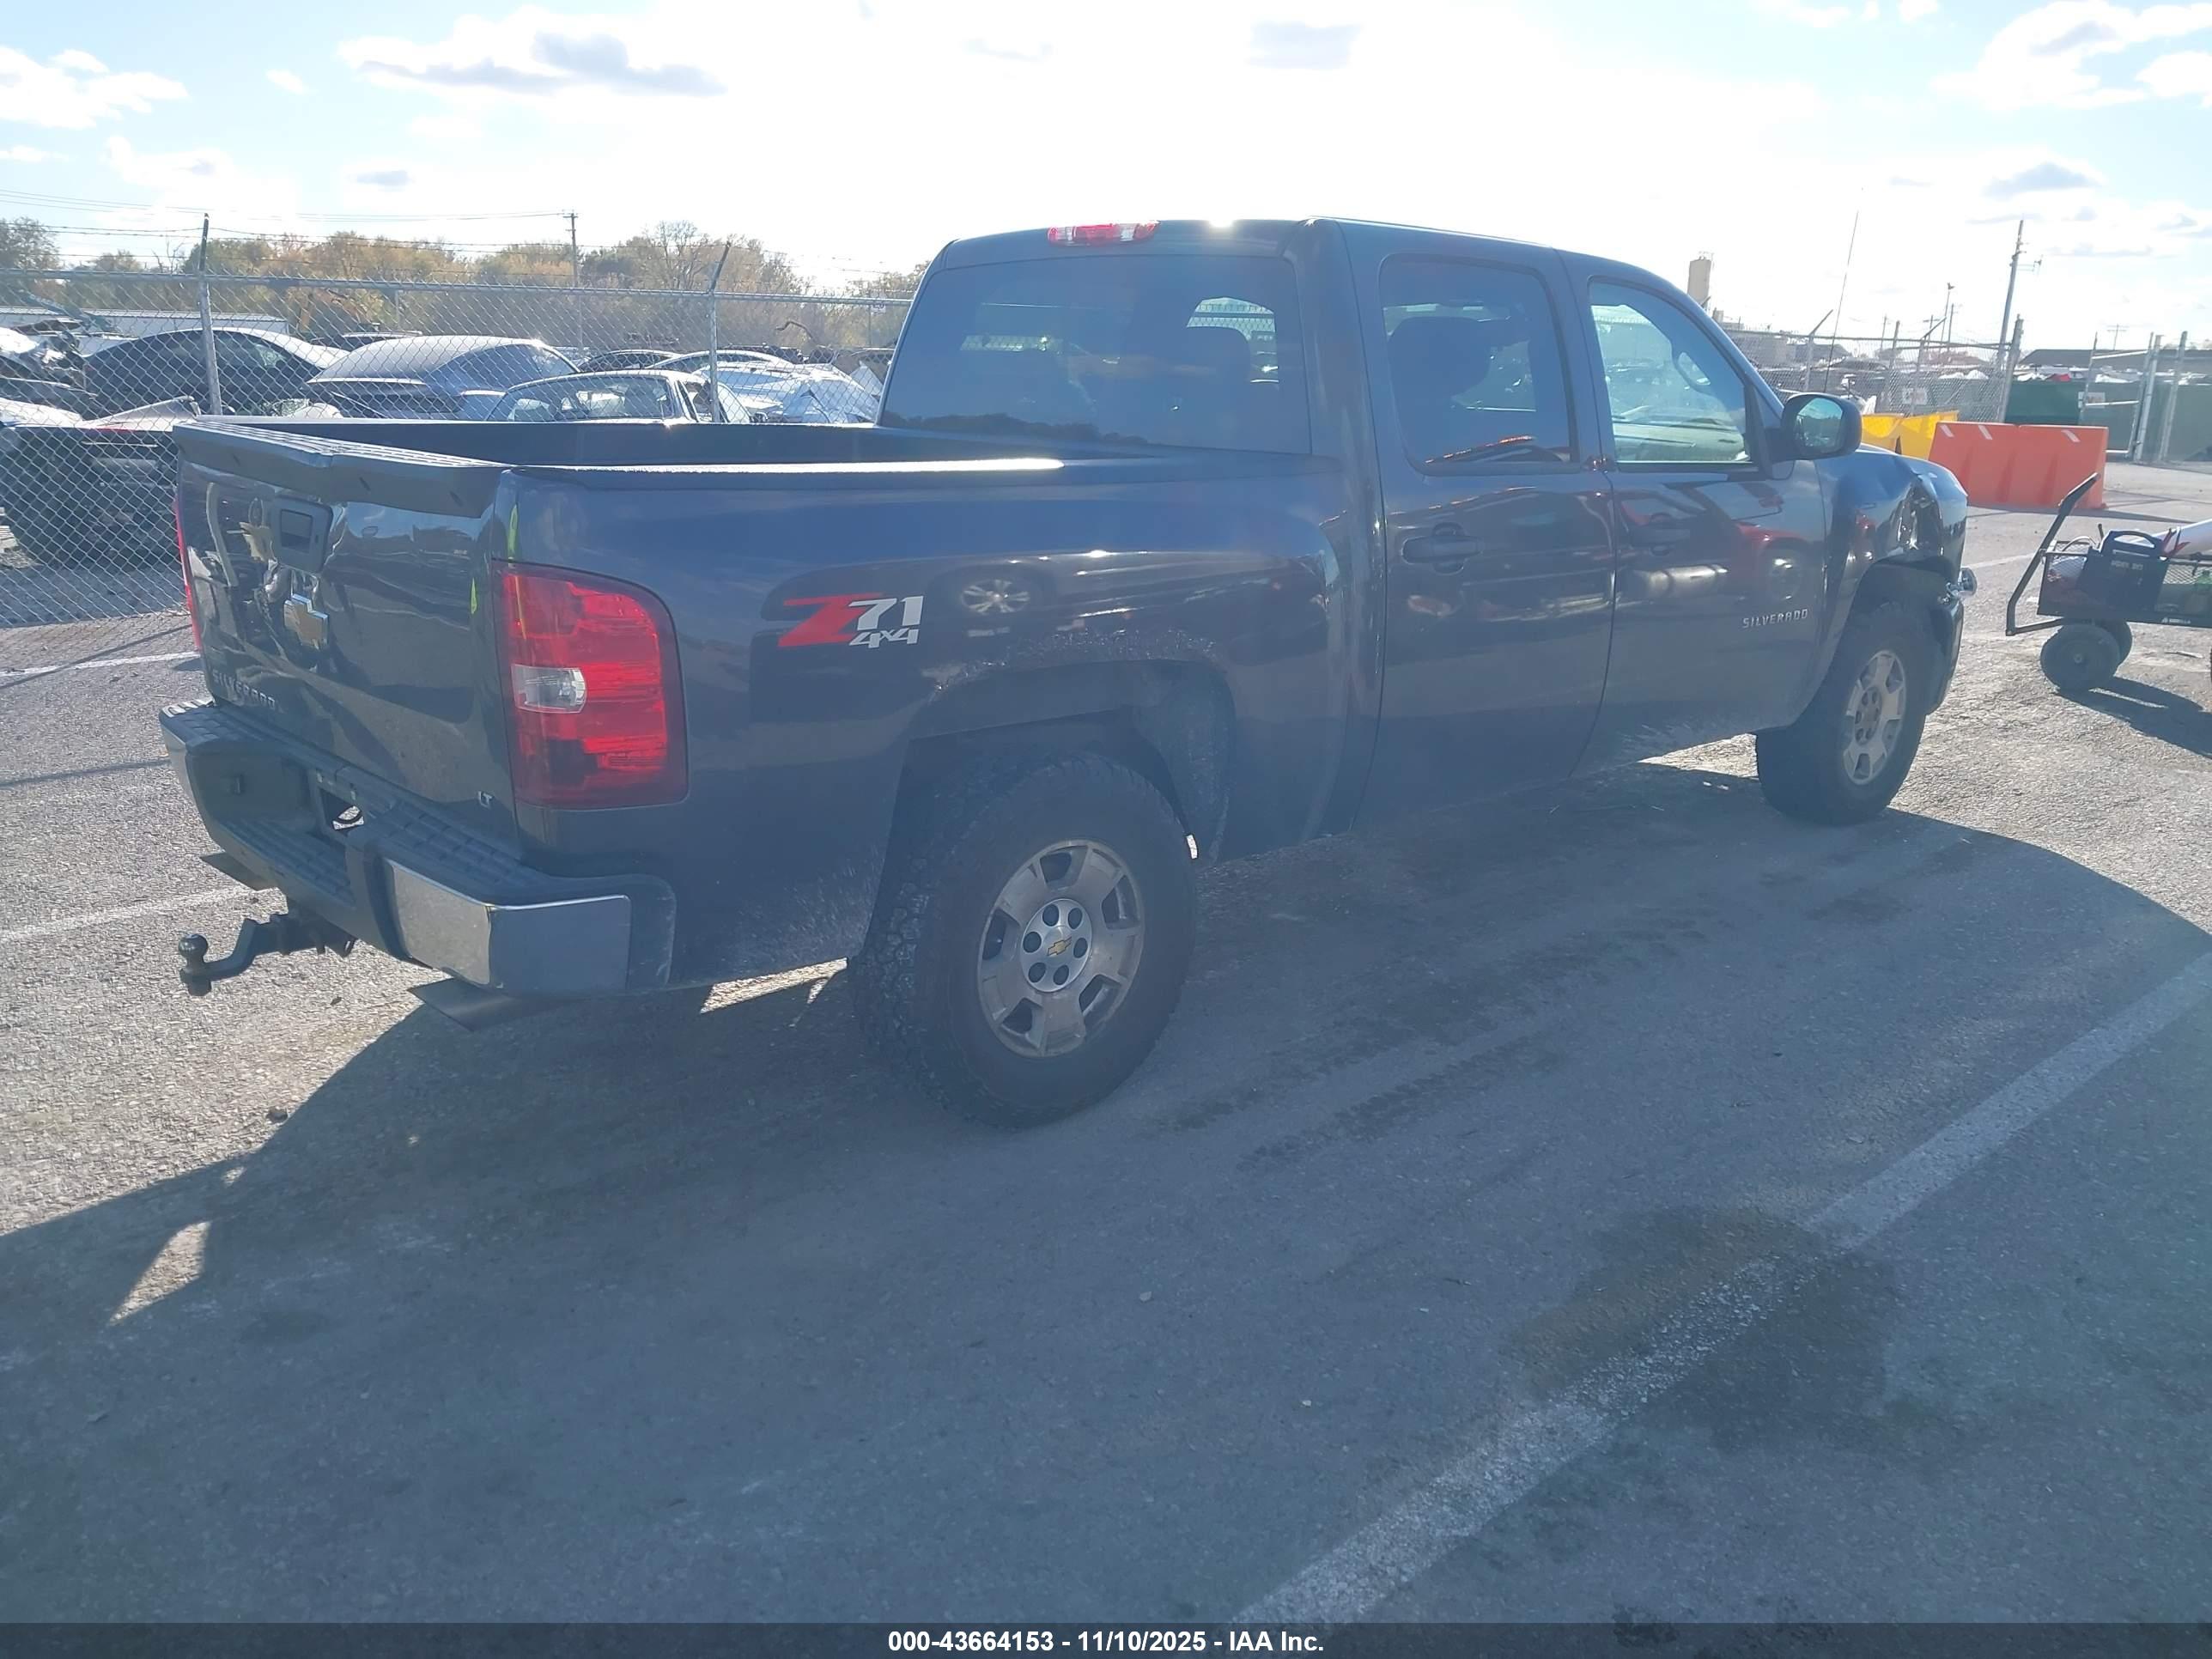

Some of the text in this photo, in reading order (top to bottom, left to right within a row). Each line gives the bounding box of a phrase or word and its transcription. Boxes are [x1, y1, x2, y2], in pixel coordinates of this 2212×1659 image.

[777, 592, 924, 647] Z71
[1742, 608, 1808, 629] SILVERADO
[477, 790, 493, 809] LT
